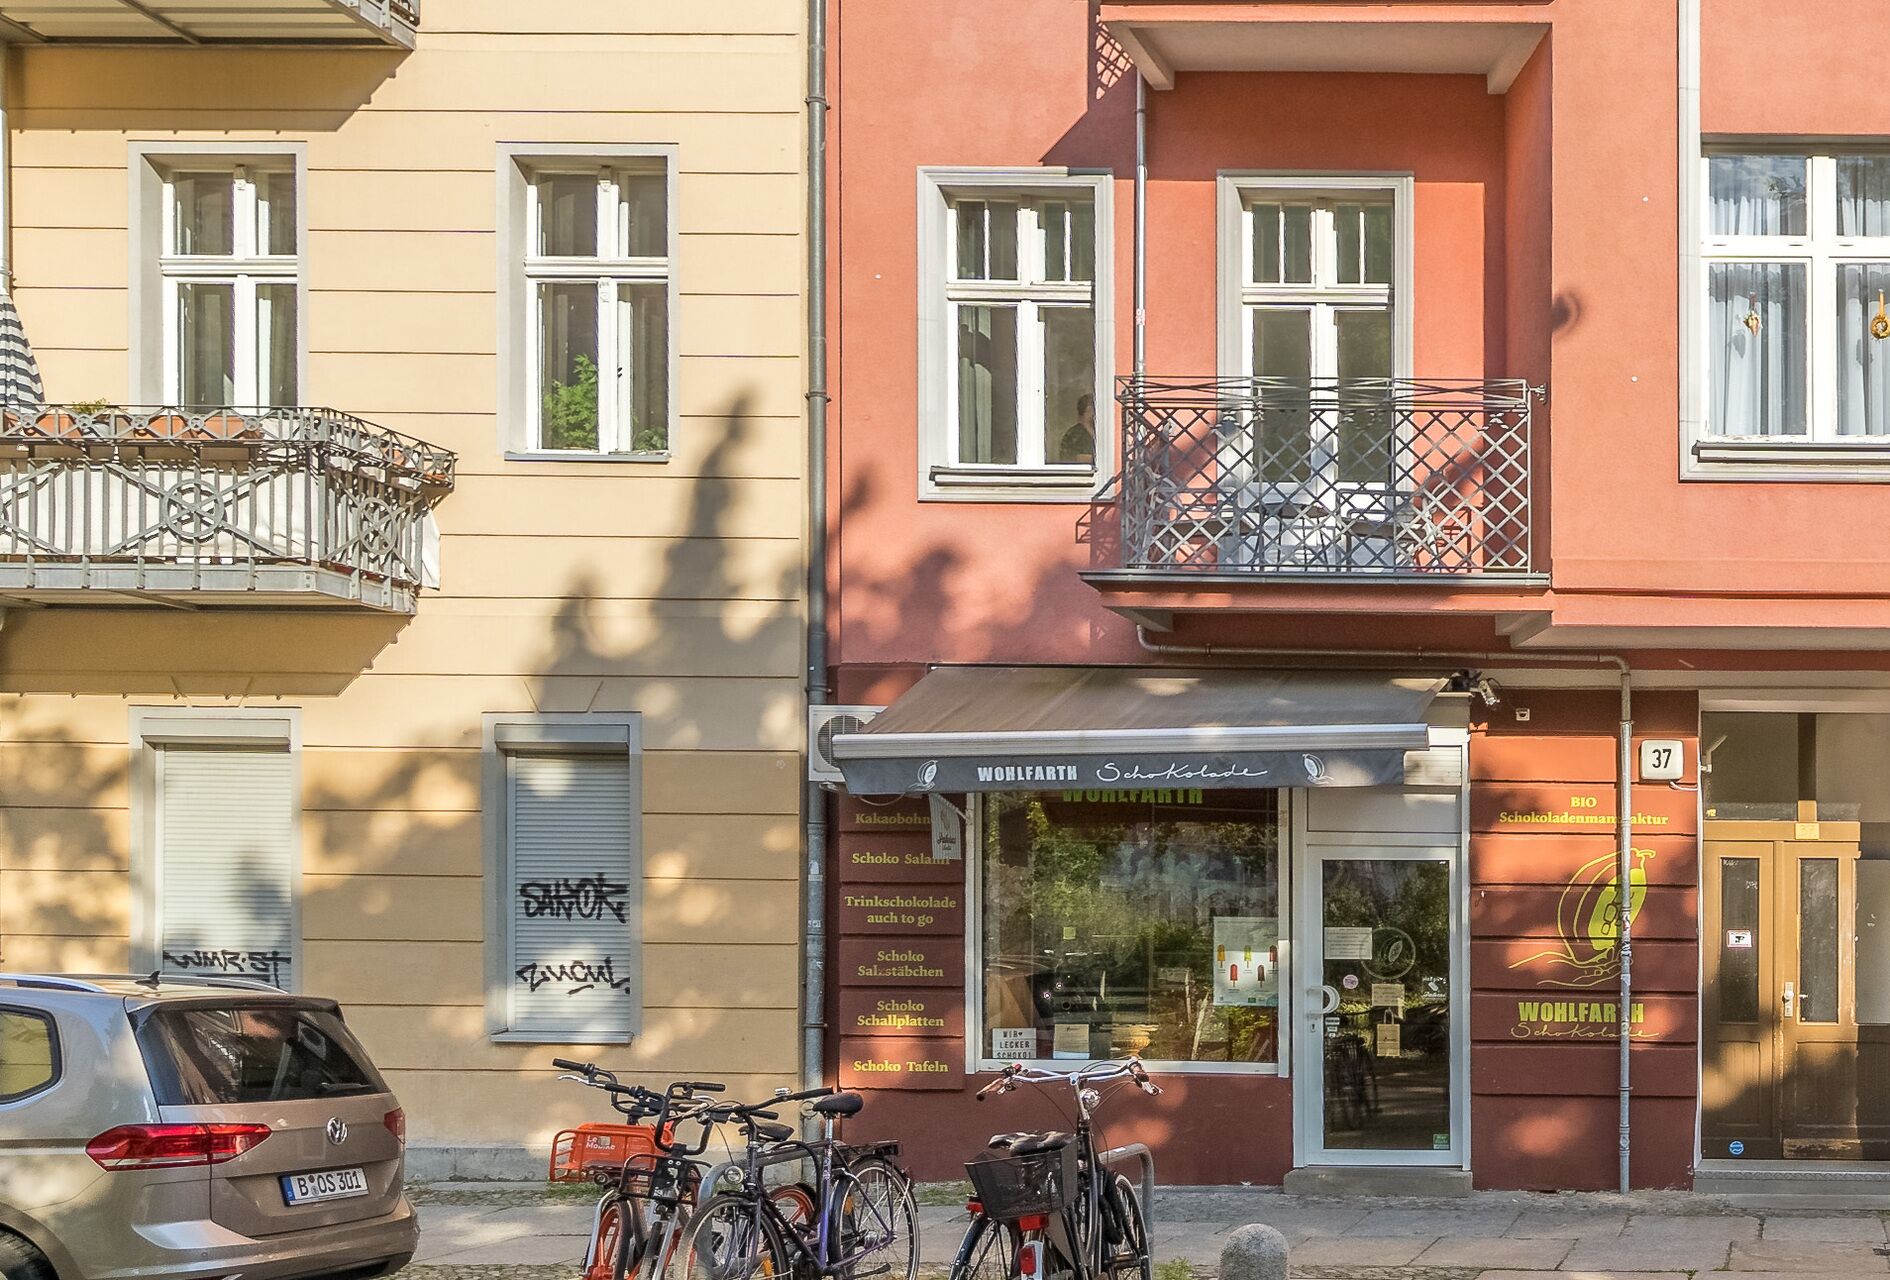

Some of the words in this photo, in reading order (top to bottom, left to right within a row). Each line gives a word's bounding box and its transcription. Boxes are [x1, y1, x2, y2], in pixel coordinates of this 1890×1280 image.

[1651, 748, 1672, 769] 37
[977, 765, 1078, 782] WOHLFARTH
[1570, 796, 1597, 808] BIO
[855, 813, 931, 825] Kakaobohn
[1499, 811, 1668, 825] Schokoladenmanaktur
[852, 852, 899, 864] Schoko
[844, 895, 956, 909] Trinkschokolade
[867, 912, 898, 923] auch
[901, 914, 914, 924] to
[917, 915, 934, 927] go
[877, 950, 924, 962] Schoko
[857, 965, 944, 977] Salstäbchen
[876, 1000, 924, 1012] Schoko
[1518, 1002, 1644, 1023] WOHLFARH
[857, 1014, 944, 1029] Schallplatten
[1000, 1041, 1030, 1049] LECKER
[853, 1060, 901, 1072] Schoko
[906, 1060, 949, 1072] Tafeln
[297, 1177, 308, 1196] B
[317, 1174, 336, 1194] OS
[337, 1171, 361, 1191] 301
